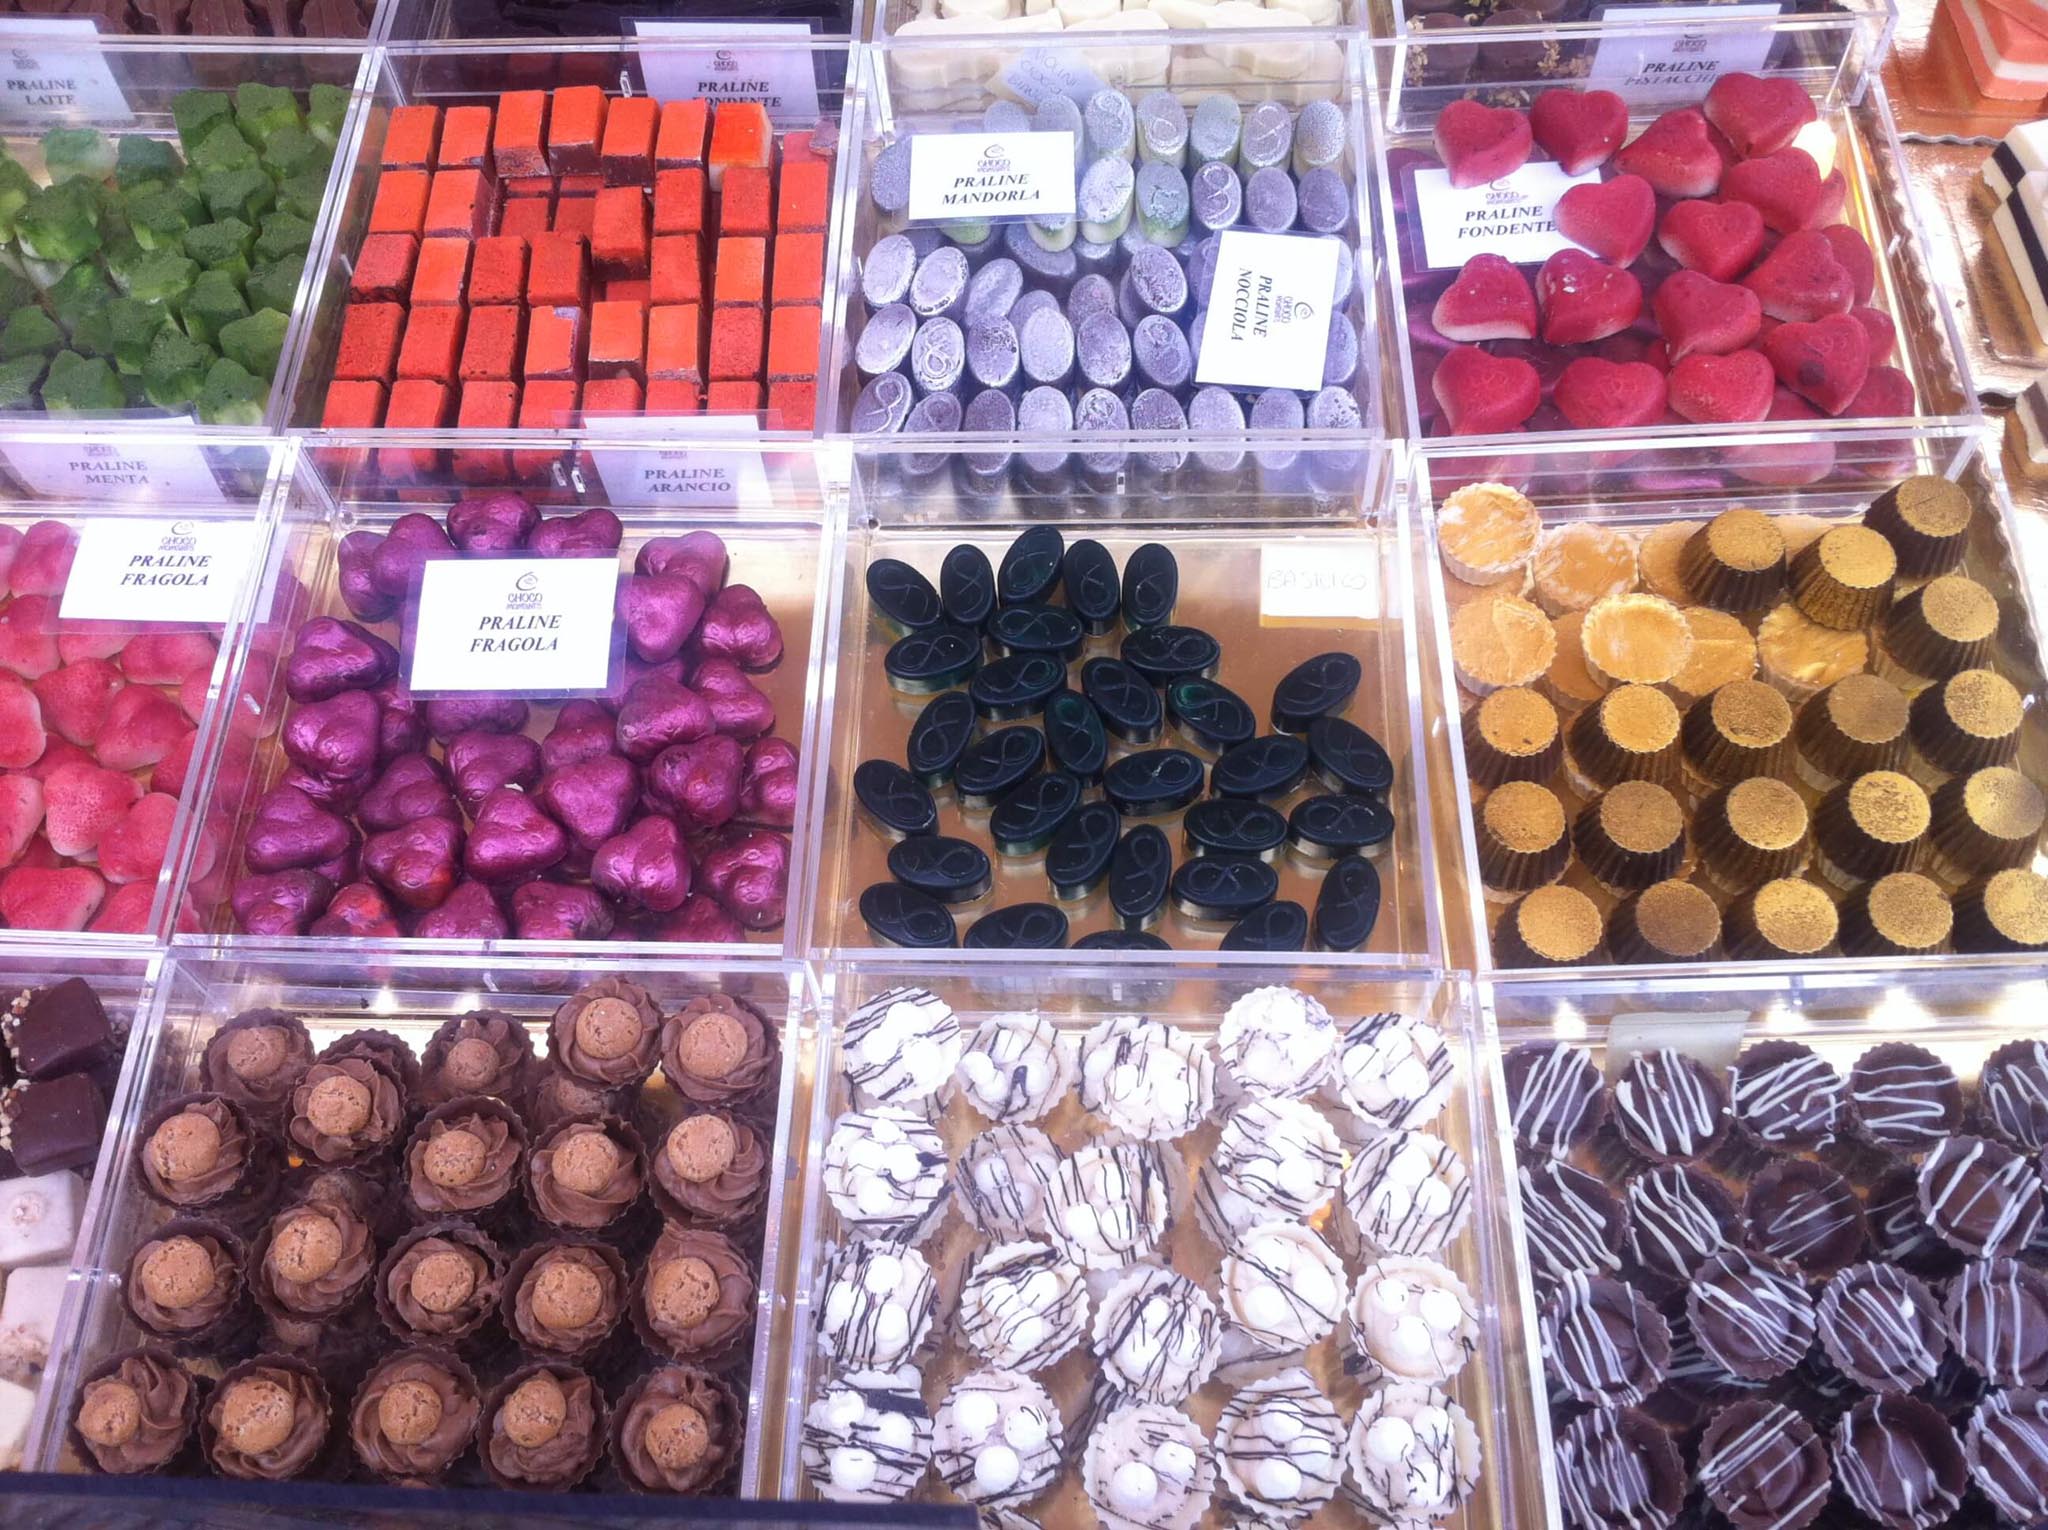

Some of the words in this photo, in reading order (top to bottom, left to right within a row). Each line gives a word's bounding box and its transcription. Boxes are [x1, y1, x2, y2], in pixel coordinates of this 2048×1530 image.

[1642, 60, 1719, 73] PRALINE
[7, 79, 77, 90] PRALINE
[1624, 73, 1718, 86] PISTACCHI
[698, 82, 769, 93] PRALINE
[25, 94, 76, 105] LATTE
[692, 96, 782, 107] ONDENTE
[954, 174, 1030, 188] PRALINE
[942, 189, 1040, 205] MANDORLA
[1465, 206, 1543, 221] PRALINE
[1458, 221, 1557, 239] FONDENTE
[1230, 266, 1252, 341] NOCCIOLA
[1253, 275, 1273, 338] PRALINE
[69, 461, 149, 471] PRALINE
[85, 474, 150, 484] MENTA
[644, 469, 725, 480] PRALINE
[647, 482, 731, 493] ARANCIO
[128, 555, 213, 568] PRALINE
[120, 573, 210, 586] FRAGOLA
[478, 615, 562, 631] PRALINE
[470, 637, 559, 653] FRAGOLA
